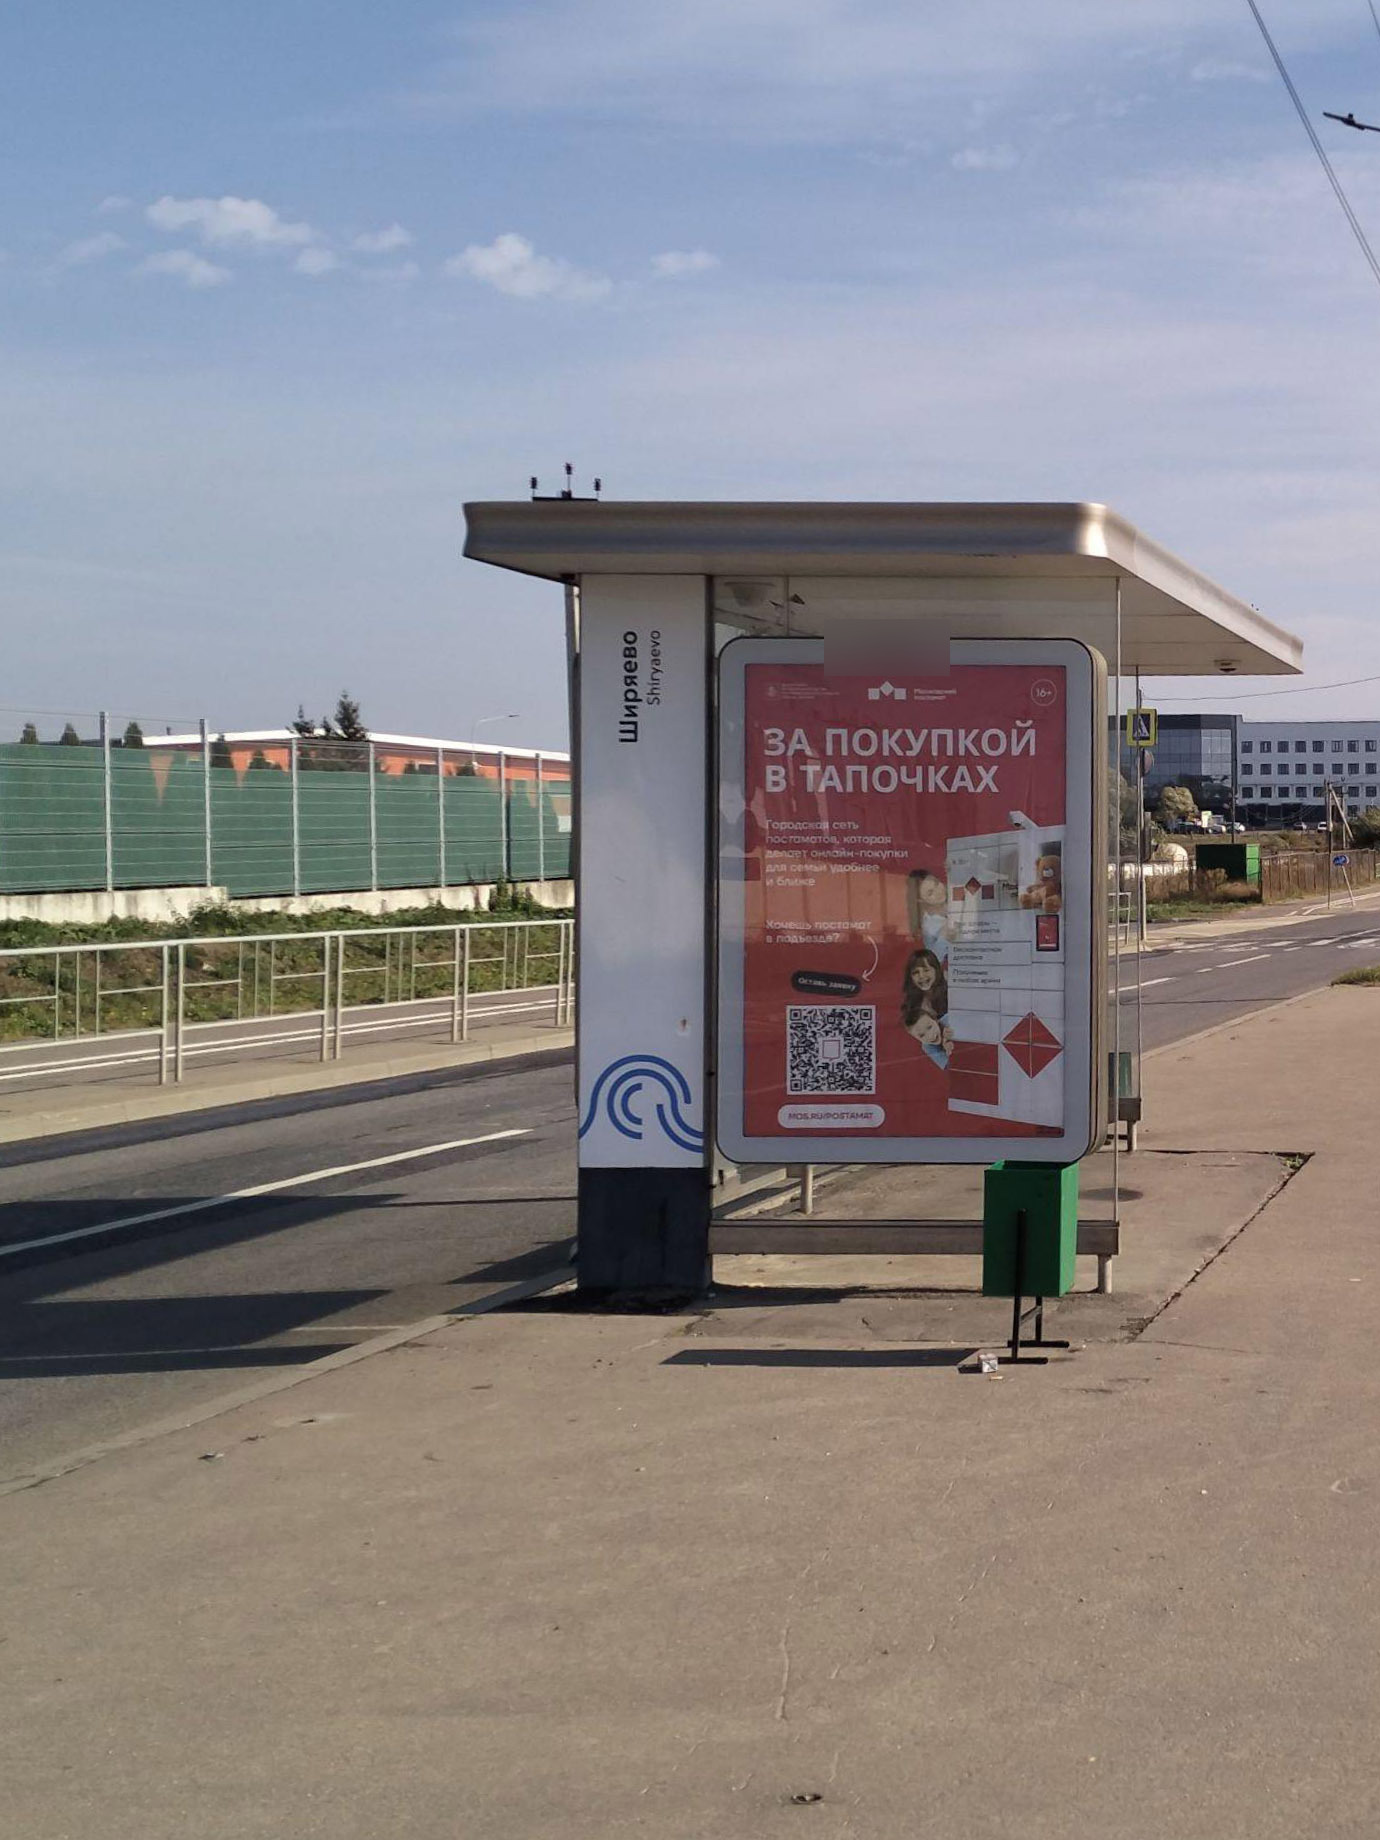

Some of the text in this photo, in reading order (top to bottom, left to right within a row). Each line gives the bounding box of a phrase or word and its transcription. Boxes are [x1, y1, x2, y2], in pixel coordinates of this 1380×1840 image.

[646, 630, 664, 706] Shiryaevo
[619, 631, 643, 743] Ширяево
[1035, 687, 1052, 698] 16+
[763, 719, 1036, 756] ЗА ПОКУПКОЙ
[765, 765, 1000, 793] В ТАПОЧКАХ
[766, 819, 859, 832] Городская сеть
[843, 835, 892, 846] которая
[765, 847, 909, 861] делает онлайн-покупки
[765, 864, 787, 873] для
[830, 862, 880, 874] удобнее
[766, 920, 872, 930] Хочешь постамат
